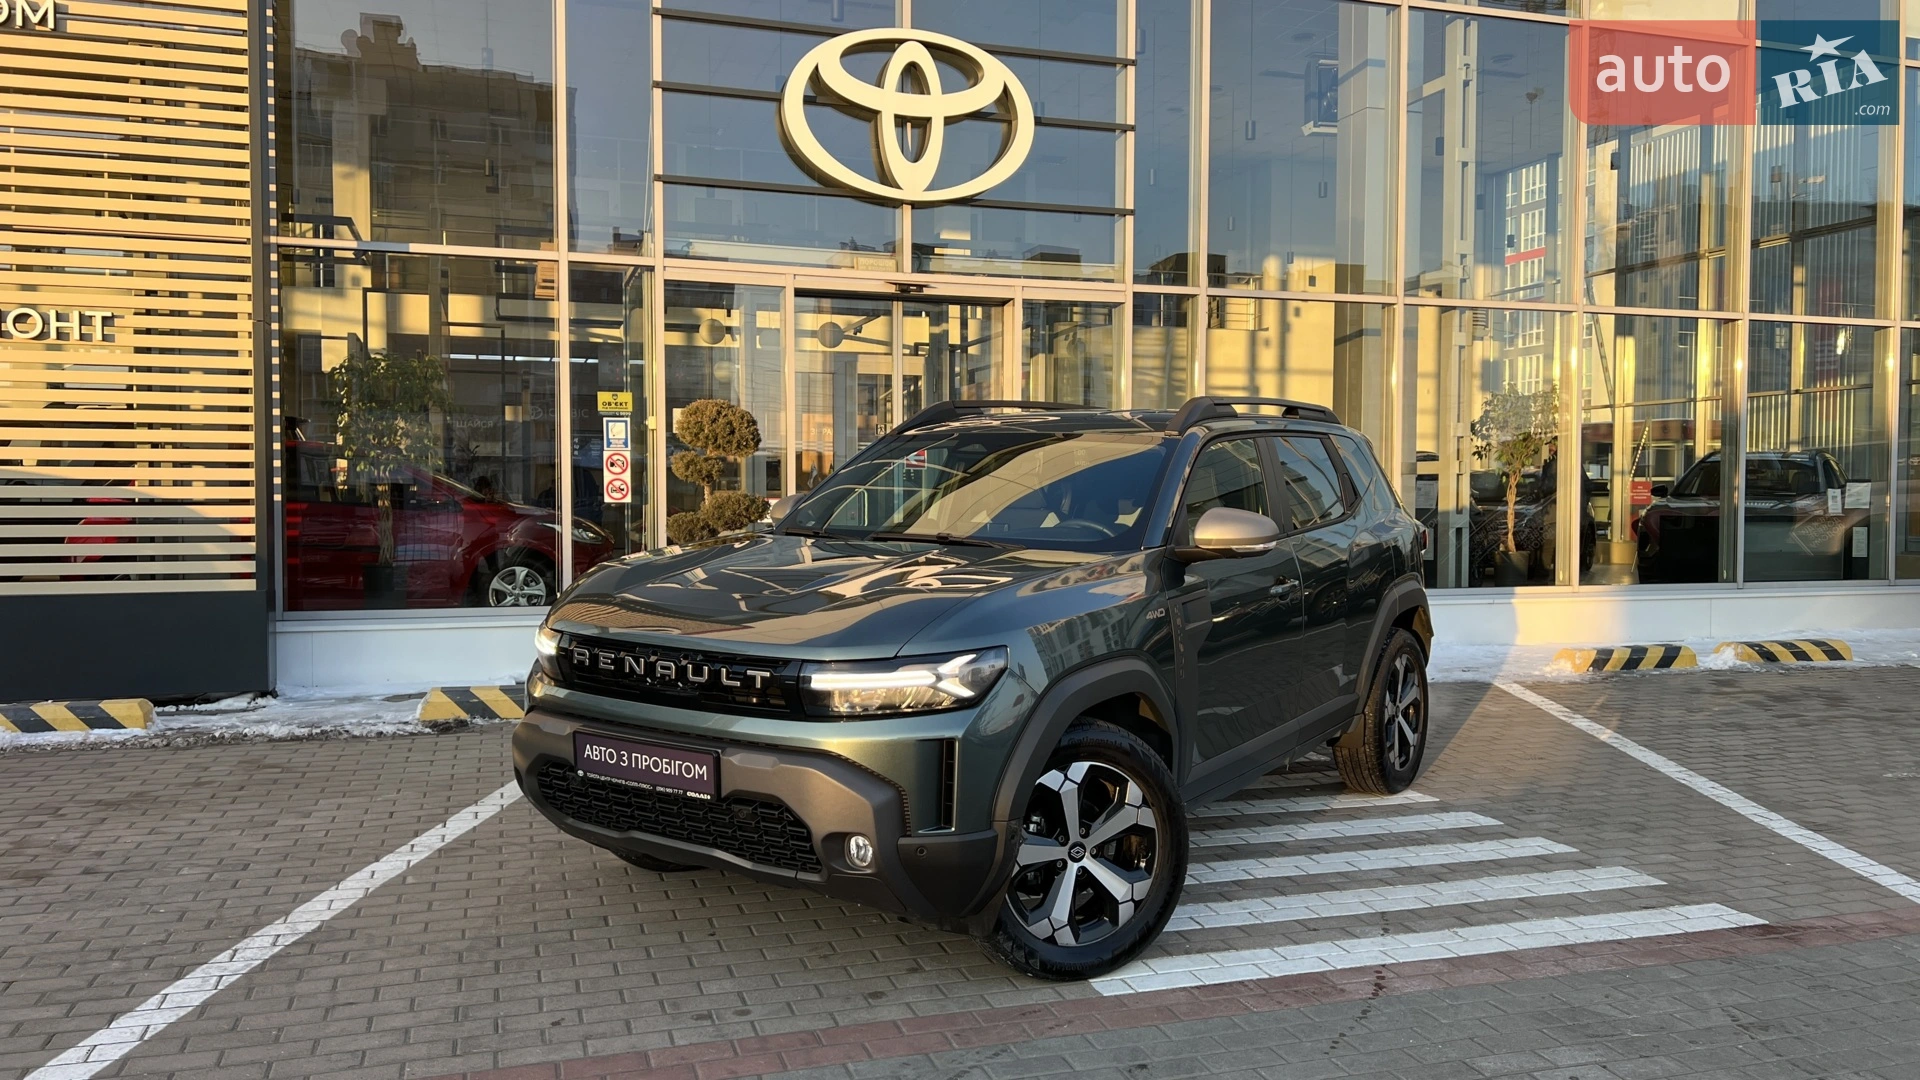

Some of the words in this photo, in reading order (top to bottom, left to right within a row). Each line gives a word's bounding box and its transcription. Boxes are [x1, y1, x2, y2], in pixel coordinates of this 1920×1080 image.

[1146, 607, 1166, 620] 4WD
[572, 647, 771, 689] RENAULT
[584, 744, 617, 764] АВТО
[631, 753, 707, 781] ПРОБІГОМ
